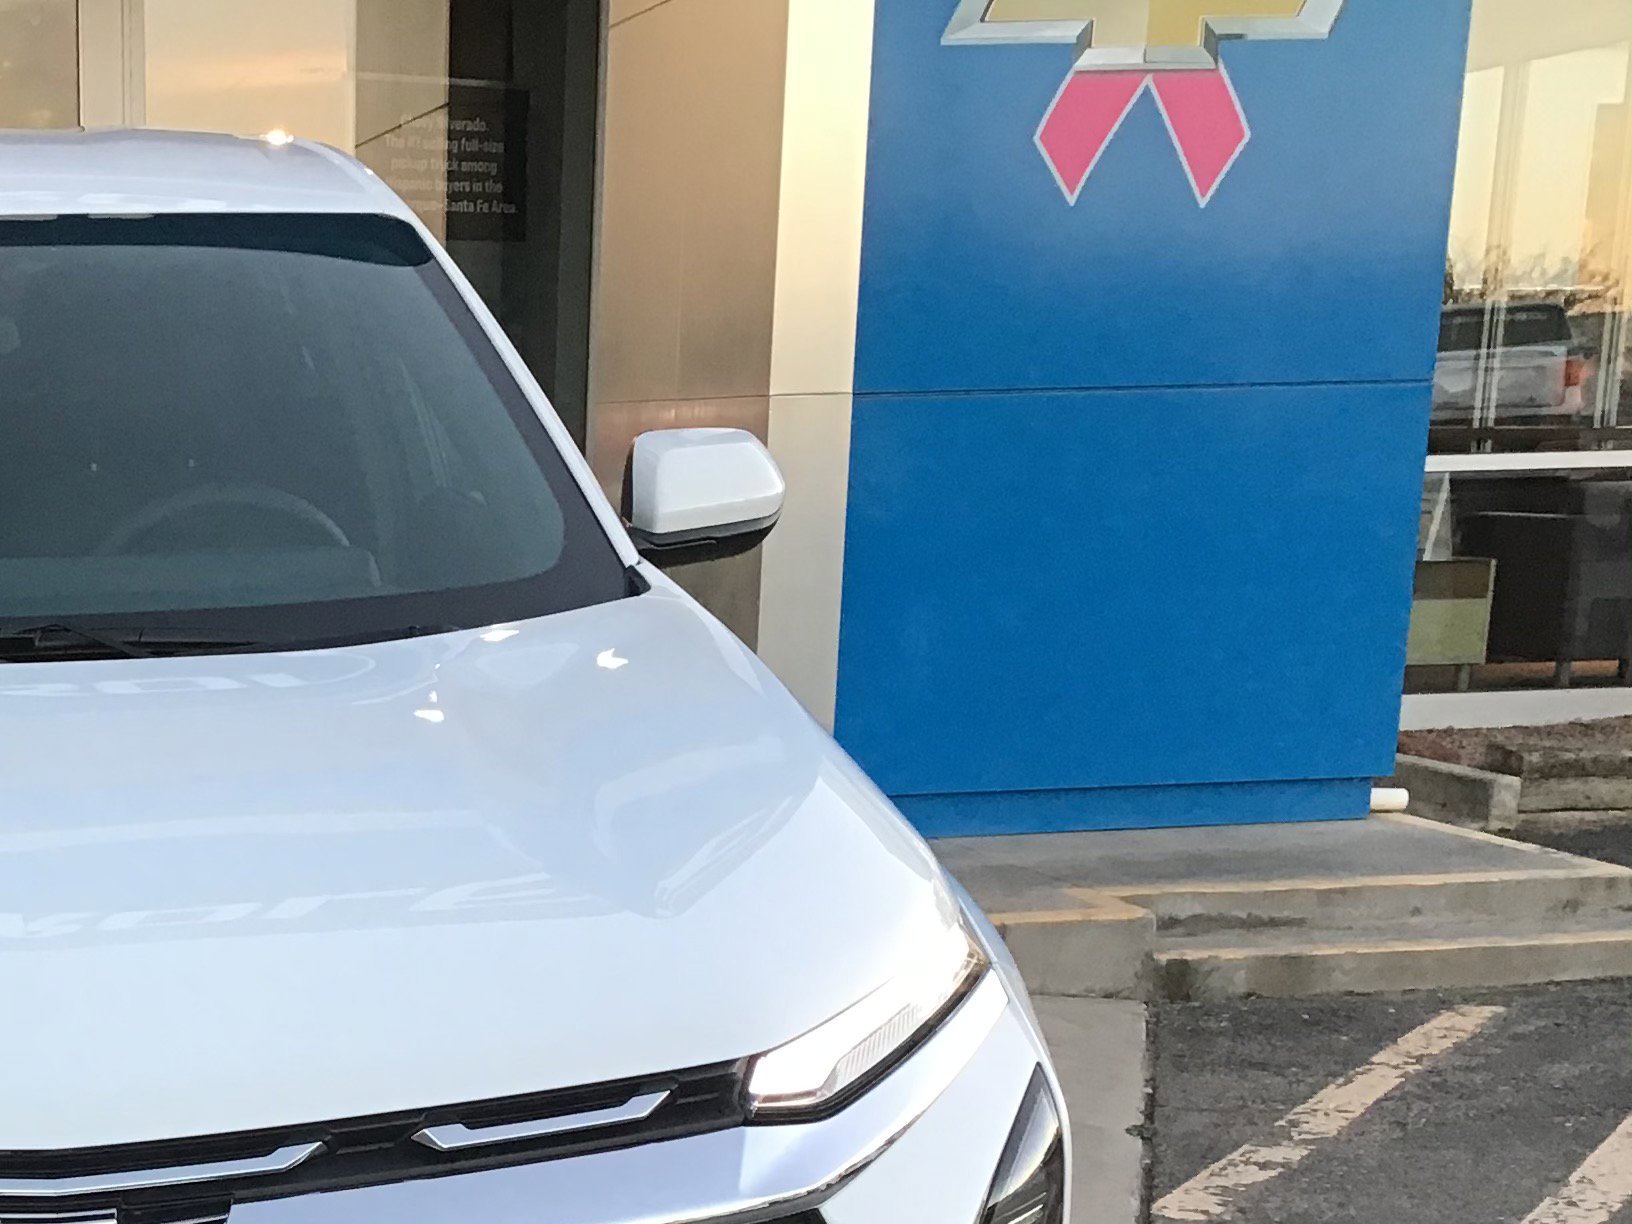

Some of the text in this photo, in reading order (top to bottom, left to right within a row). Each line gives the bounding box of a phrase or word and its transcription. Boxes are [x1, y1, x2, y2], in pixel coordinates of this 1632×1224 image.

[460, 137, 504, 153] full-size
[460, 160, 498, 175] among
[472, 177, 483, 193] in
[484, 178, 503, 193] the
[476, 199, 489, 213] Fe
